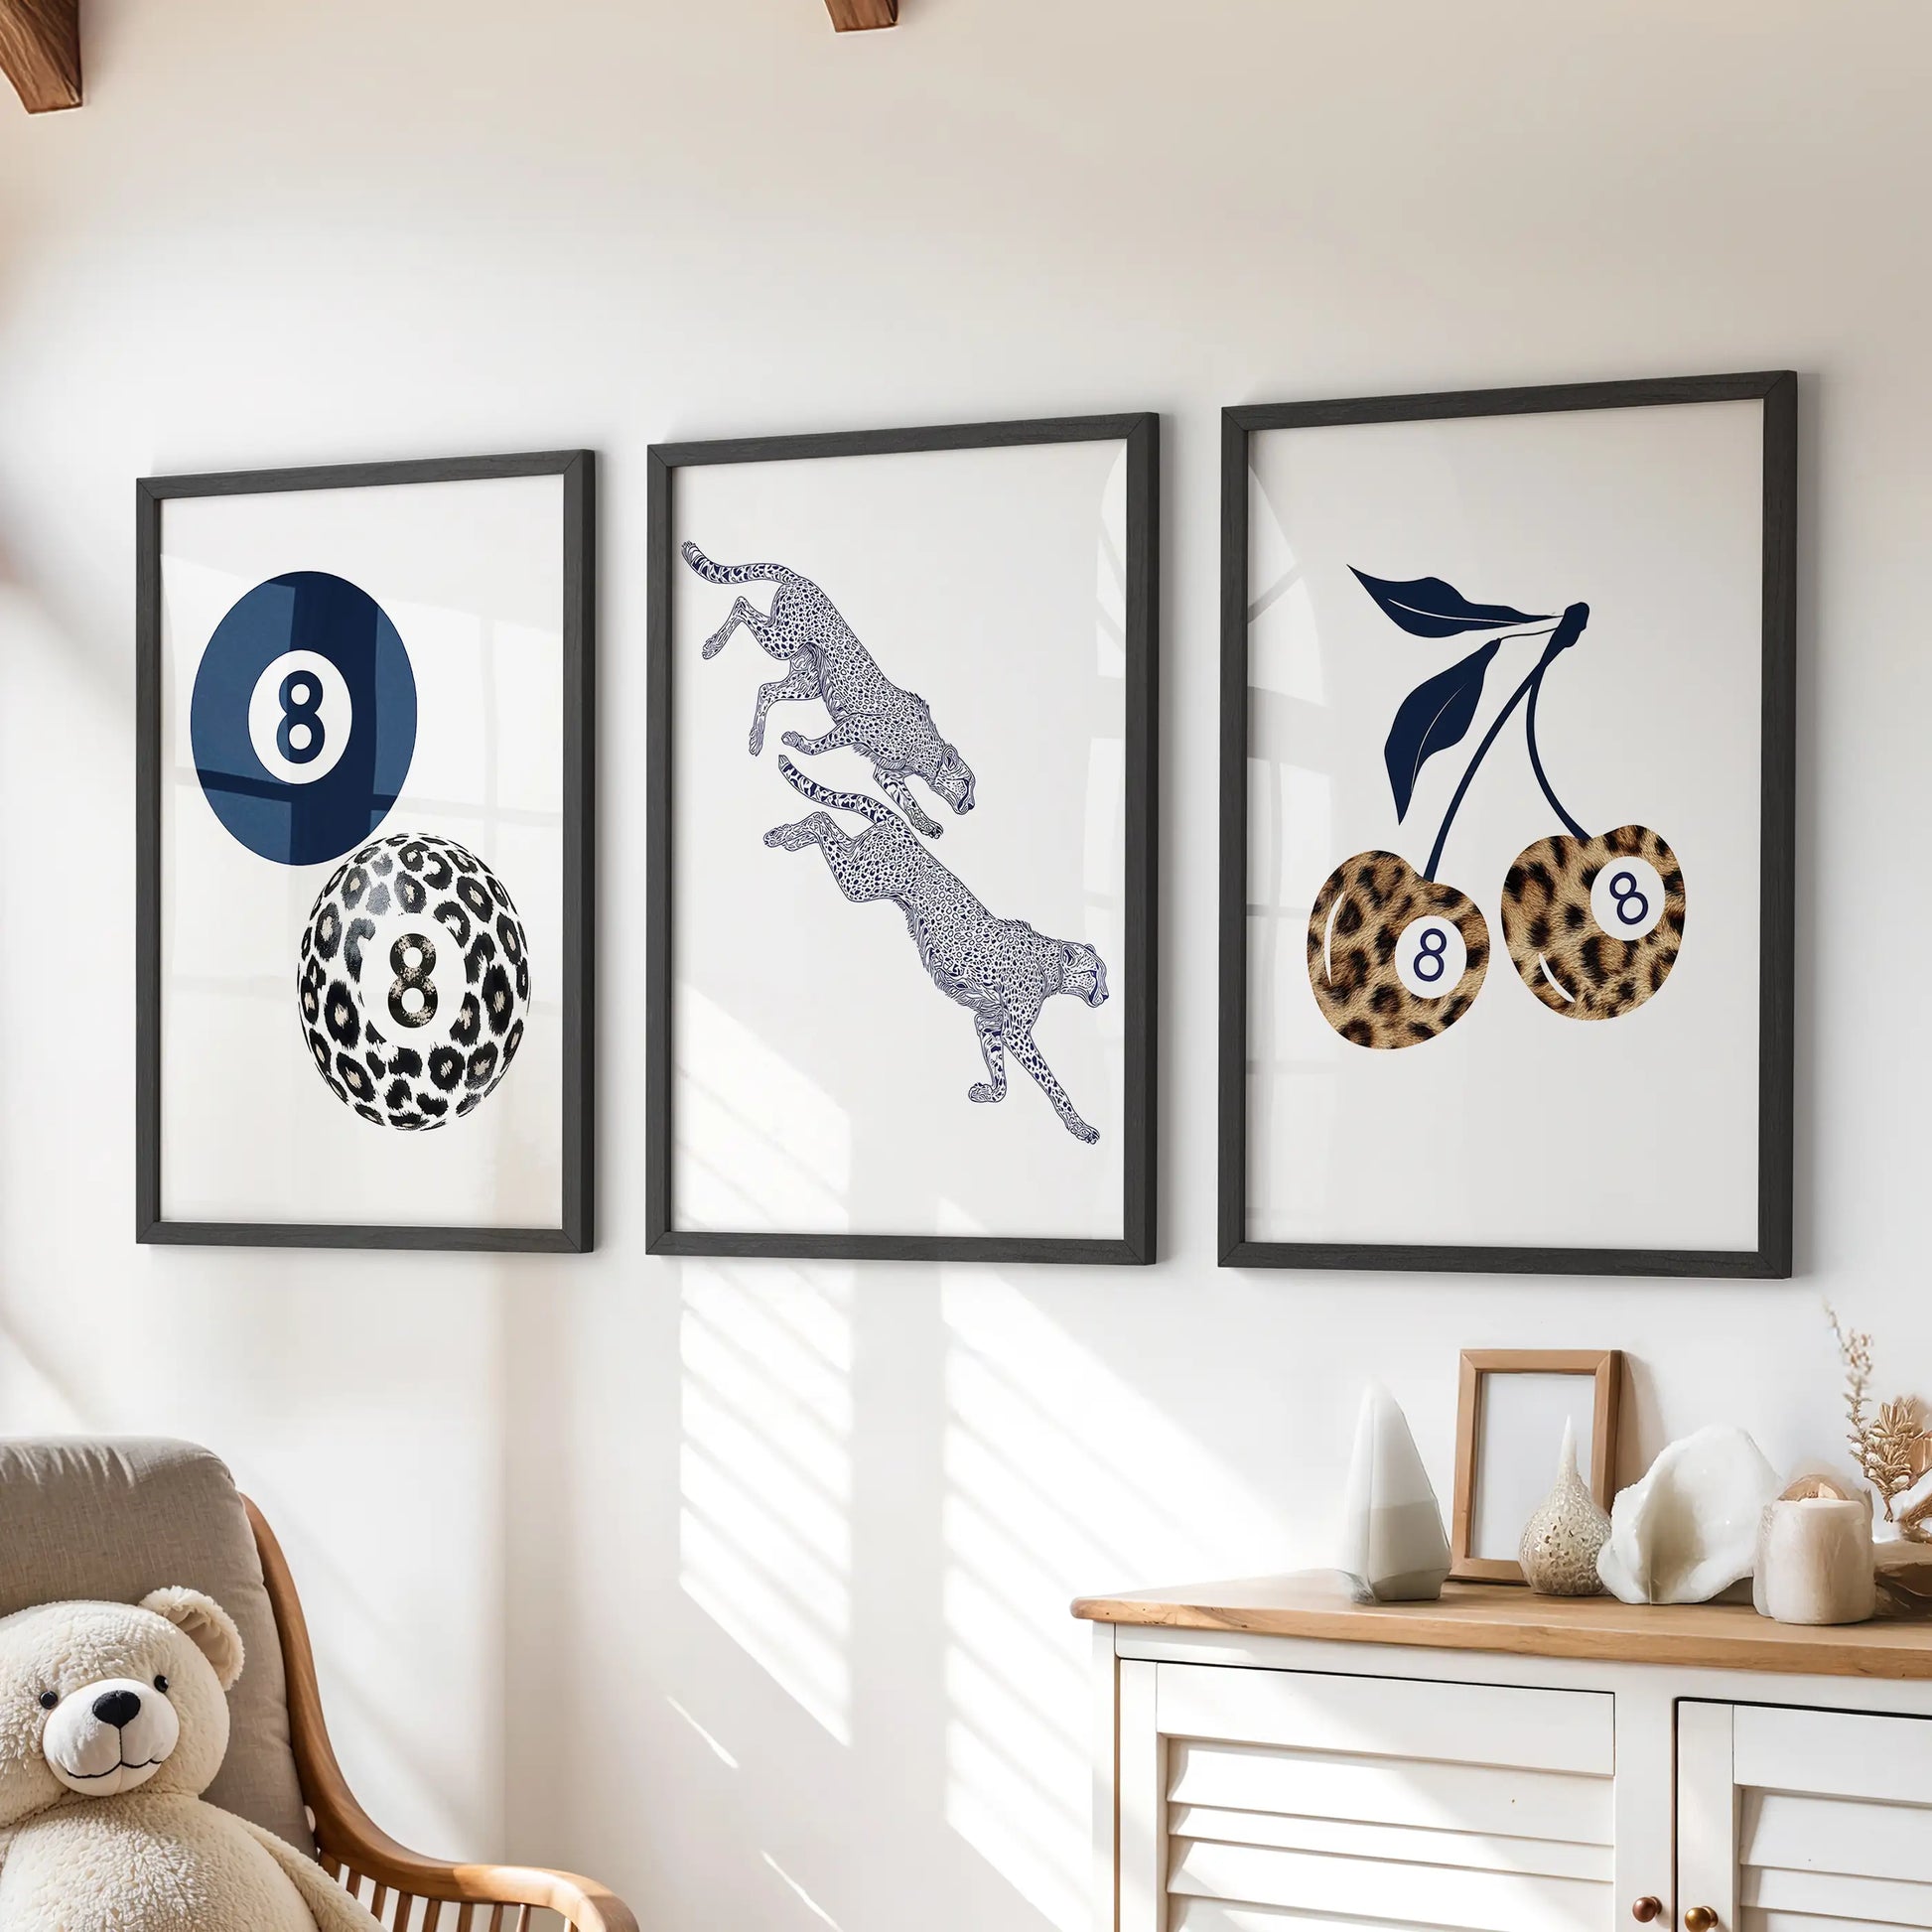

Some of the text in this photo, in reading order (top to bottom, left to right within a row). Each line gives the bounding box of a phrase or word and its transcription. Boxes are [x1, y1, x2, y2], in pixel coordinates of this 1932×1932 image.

[275, 669, 325, 765] 8
[1609, 871, 1649, 926] 8
[387, 932, 439, 1030] 8
[1413, 927, 1448, 983] 8
